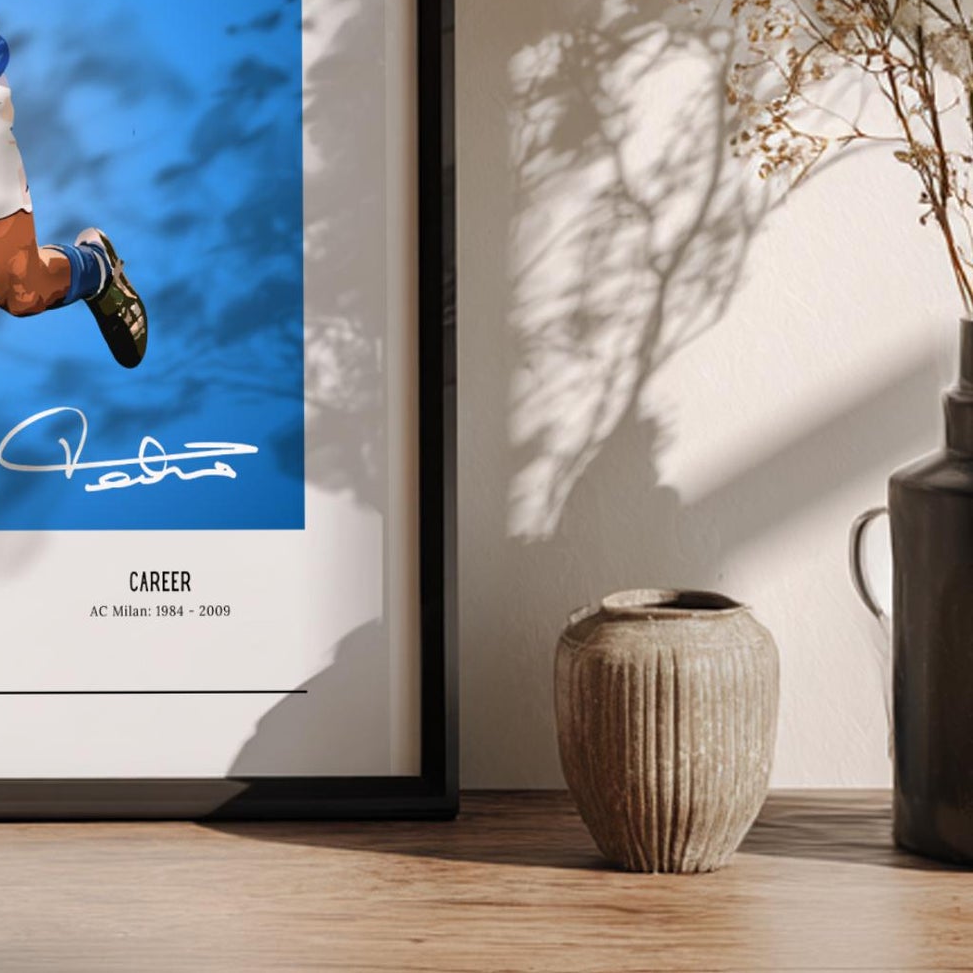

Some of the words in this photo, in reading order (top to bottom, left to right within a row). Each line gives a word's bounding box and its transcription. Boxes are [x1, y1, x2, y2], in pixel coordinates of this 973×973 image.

[129, 570, 191, 592] CAREER
[89, 605, 108, 618] AC
[112, 604, 152, 618] Milan:
[155, 604, 184, 618] 1984
[198, 604, 231, 617] 2009
